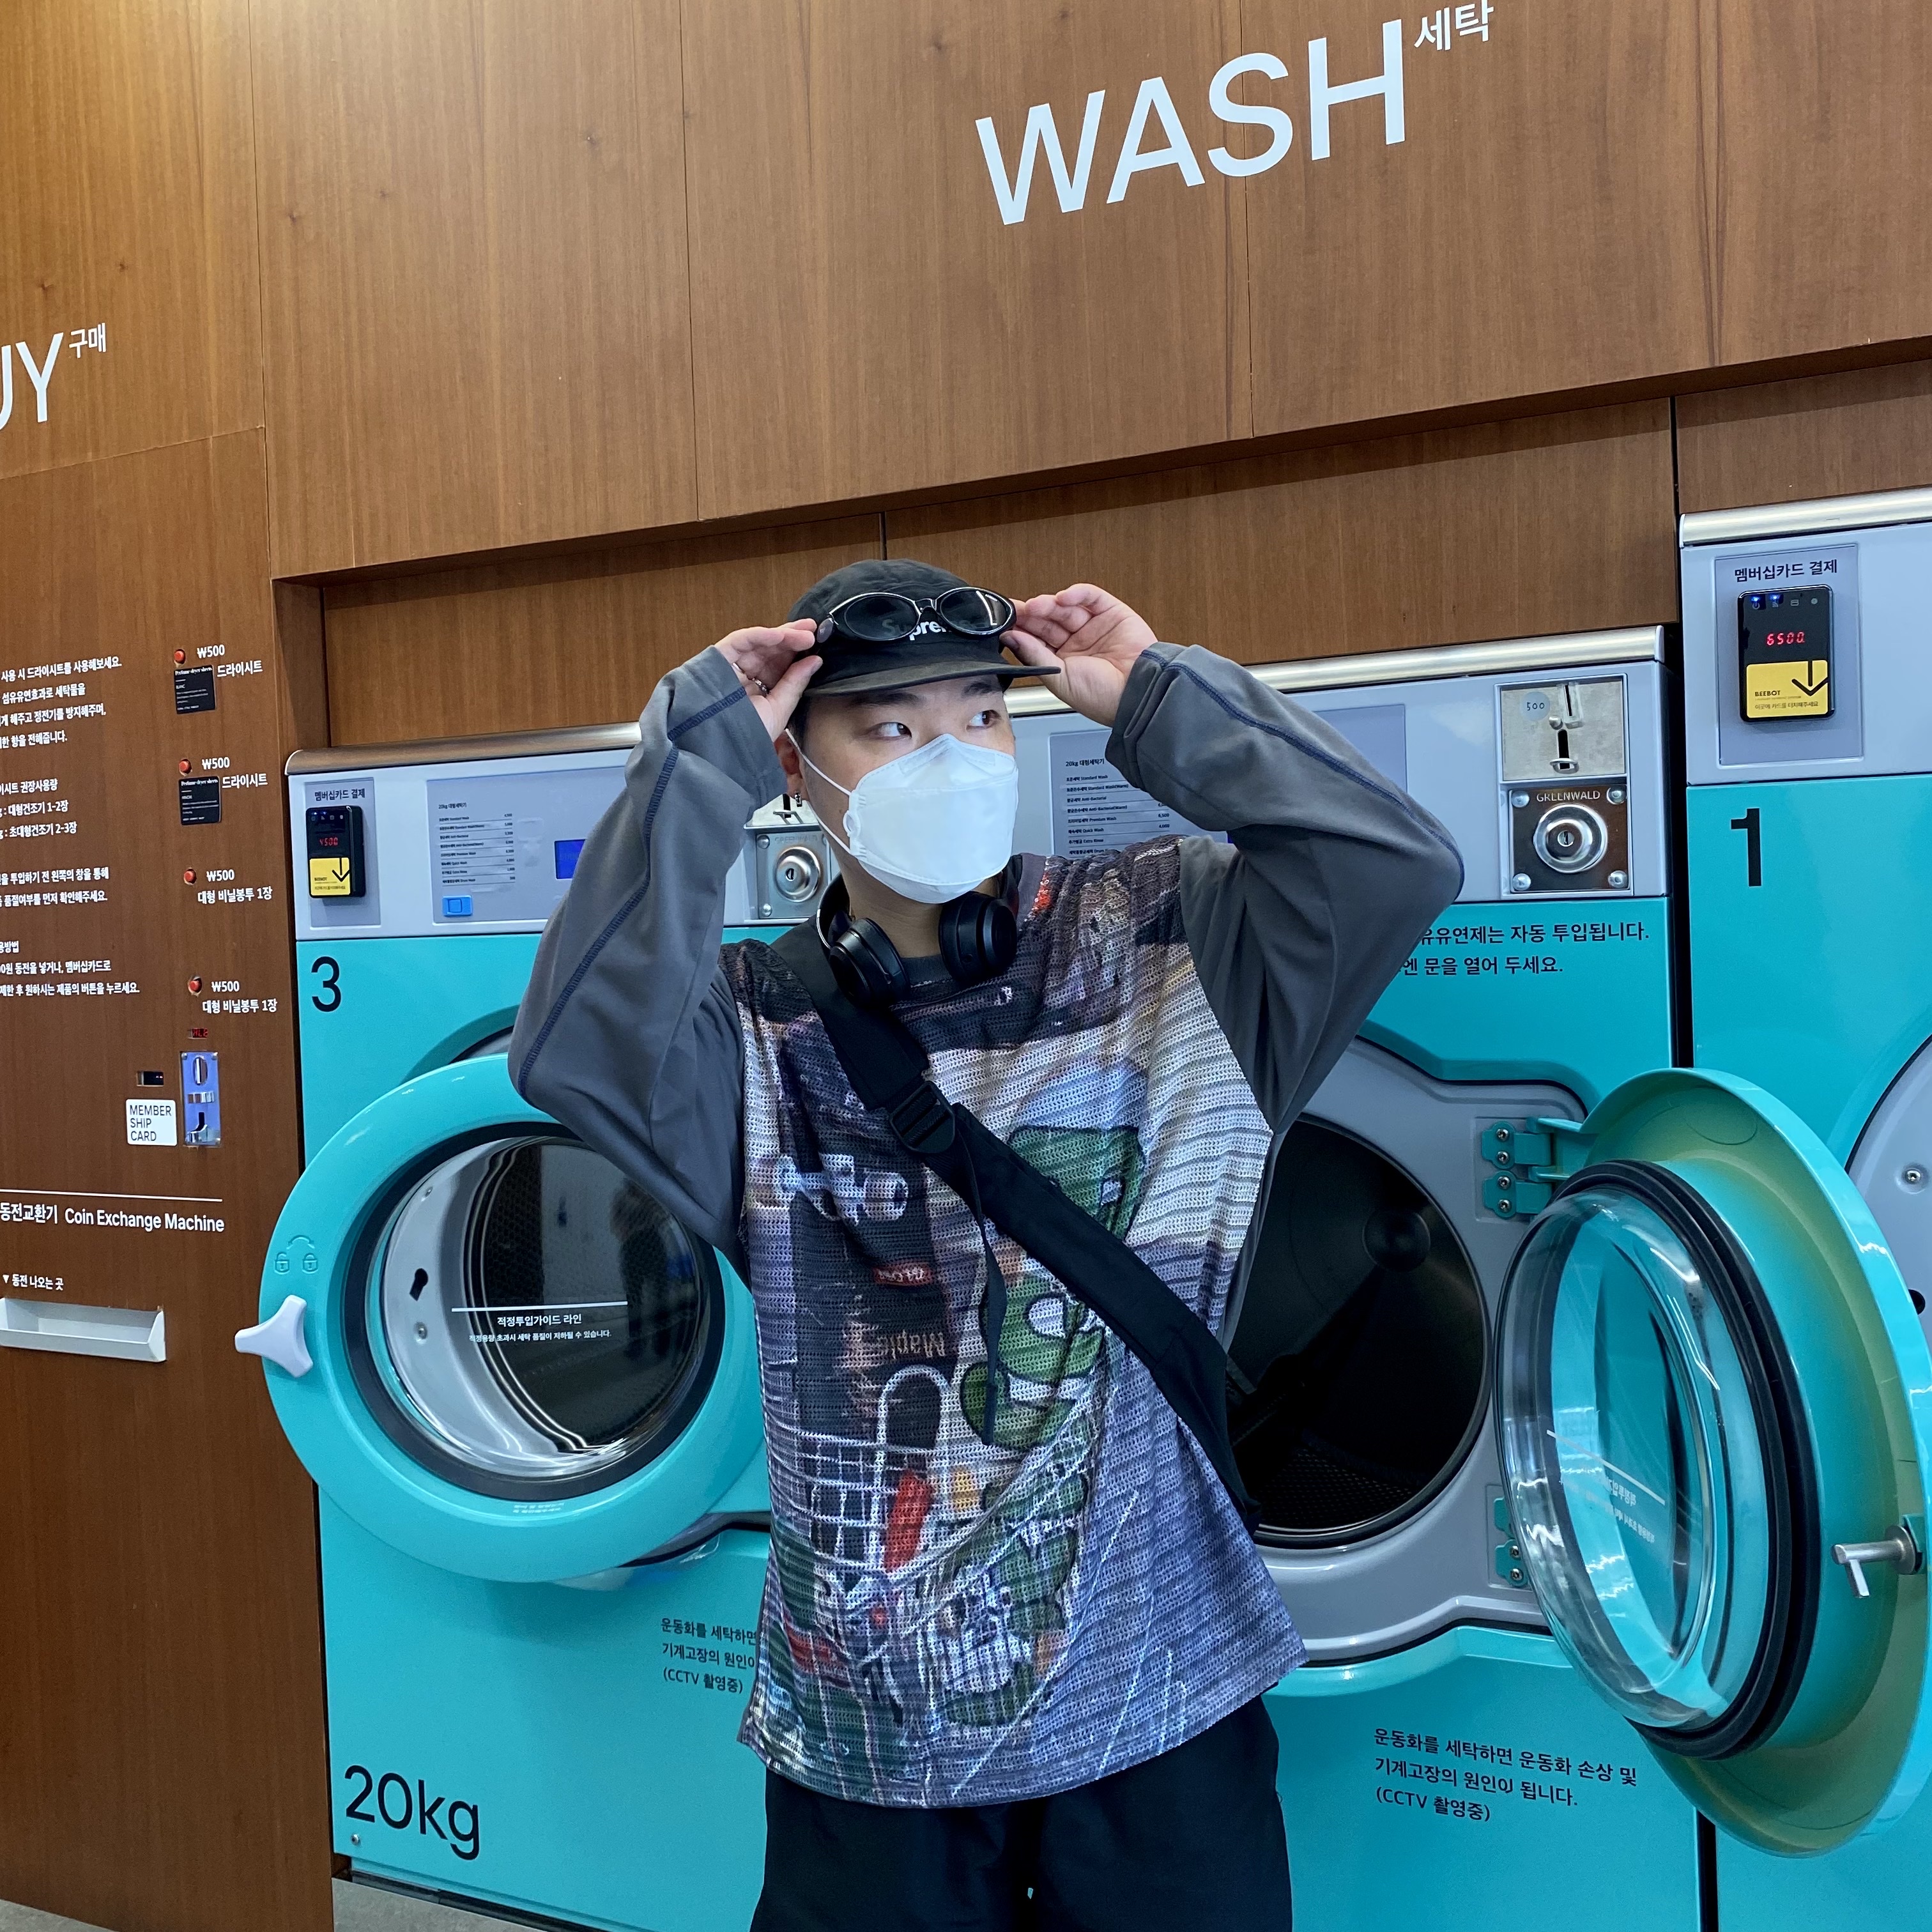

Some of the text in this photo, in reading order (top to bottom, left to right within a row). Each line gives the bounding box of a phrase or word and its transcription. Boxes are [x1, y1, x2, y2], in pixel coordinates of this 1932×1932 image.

[1414, 0, 1494, 50] 세탁
[976, 19, 1405, 226] WASH
[69, 323, 106, 358] 구매
[1735, 559, 1837, 583] 멤버십카드 결제
[1767, 631, 1805, 646] 6500
[1, 656, 122, 682] 사용 시 드라이시트를 사용해보세요.
[217, 660, 263, 677] 드라이시트
[2, 682, 86, 705] 섬유유연효과로 세탁물을
[0, 703, 107, 727] 게 해주고 정전기를 방지해주며,
[1527, 702, 1545, 711] 500
[0, 736, 9, 749] 한
[27, 730, 68, 746] 전해줍니다.
[20, 778, 58, 793] 권장사용량
[222, 773, 268, 789] 드라이시트
[314, 788, 365, 801] 멤버십카드 결제
[1537, 790, 1600, 802] GREENWALD
[8, 801, 45, 816] 대형건조기
[47, 799, 68, 813] 1-2장
[9, 823, 54, 838] 초대형건조기
[56, 821, 77, 834] 2-3장
[1731, 808, 1761, 887] 1
[0, 866, 109, 885] 을 투입하기 전 왼쪽의 창을 통해
[4, 890, 108, 907] 품절여부를 먼저 확인해주세요.
[197, 886, 273, 905] 대형 비닐봉투 1장
[1510, 924, 1546, 944] 자동
[1552, 921, 1650, 943] 투입됩니다.
[15, 962, 37, 974] 동전을
[38, 961, 64, 974] 넣거나,
[65, 960, 111, 974] 멤버십카드로
[1397, 955, 1563, 976] 엔 문을 열어 두세요.
[15, 984, 24, 997] 후
[25, 983, 55, 996] 원하시는
[56, 983, 80, 996] 제품의
[81, 982, 104, 995] 버튼을
[106, 981, 140, 995] 누르세요.
[311, 956, 342, 1013] 3
[202, 998, 278, 1014] 대형 비닐봉투 1장
[130, 1105, 172, 1116] MEMBER
[130, 1117, 152, 1128] SHIP
[130, 1131, 157, 1142] CARD
[0, 1202, 225, 1232] 동전교환기 Coin Exchange Machine
[12, 1273, 64, 1291] 동전 나오는 곳
[497, 1314, 582, 1327] 적정투입가이드 라인
[496, 1334, 516, 1342] 초과시
[517, 1333, 531, 1342] 세탁
[533, 1332, 552, 1341] 품질이
[575, 1331, 582, 1339] 수
[583, 1329, 611, 1339] 있습니다.
[661, 1618, 707, 1639] 운동화를
[663, 1643, 720, 1666] 기계고장의
[663, 1666, 742, 1694] (CCTV 촬영중)
[1374, 1728, 1637, 1787] 운동화를 세탁하면 운동화 손상 및
[1376, 1758, 1577, 1806] 기계고장의 원인이 됩니다.
[344, 1765, 480, 1860] 20kg
[1376, 1786, 1490, 1821] (CCTV 촬영중)
